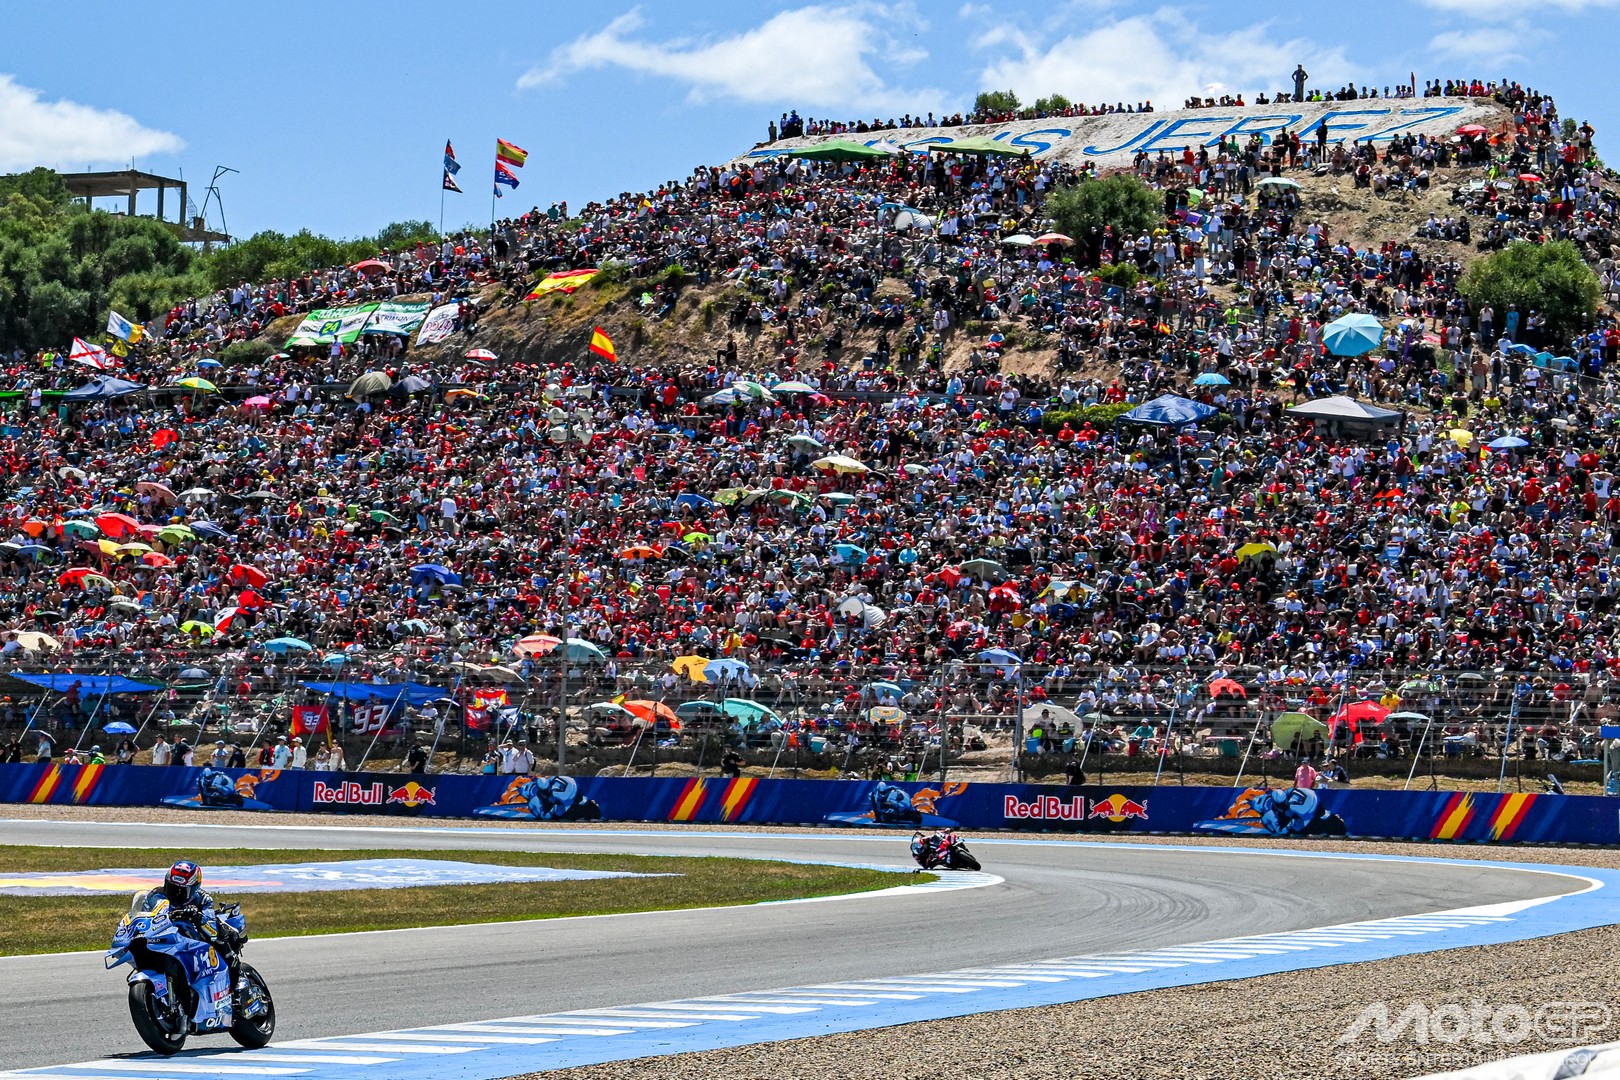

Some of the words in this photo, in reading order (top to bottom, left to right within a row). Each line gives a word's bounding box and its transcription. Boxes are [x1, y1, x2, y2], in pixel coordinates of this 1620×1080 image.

[1083, 106, 1465, 155] JEREZ
[321, 321, 339, 335] 24
[305, 715, 320, 726] 93
[352, 704, 389, 734] 93
[313, 781, 348, 803] Red
[349, 782, 383, 804] Bull
[1004, 795, 1044, 819] Red
[1046, 796, 1084, 820] Bull
